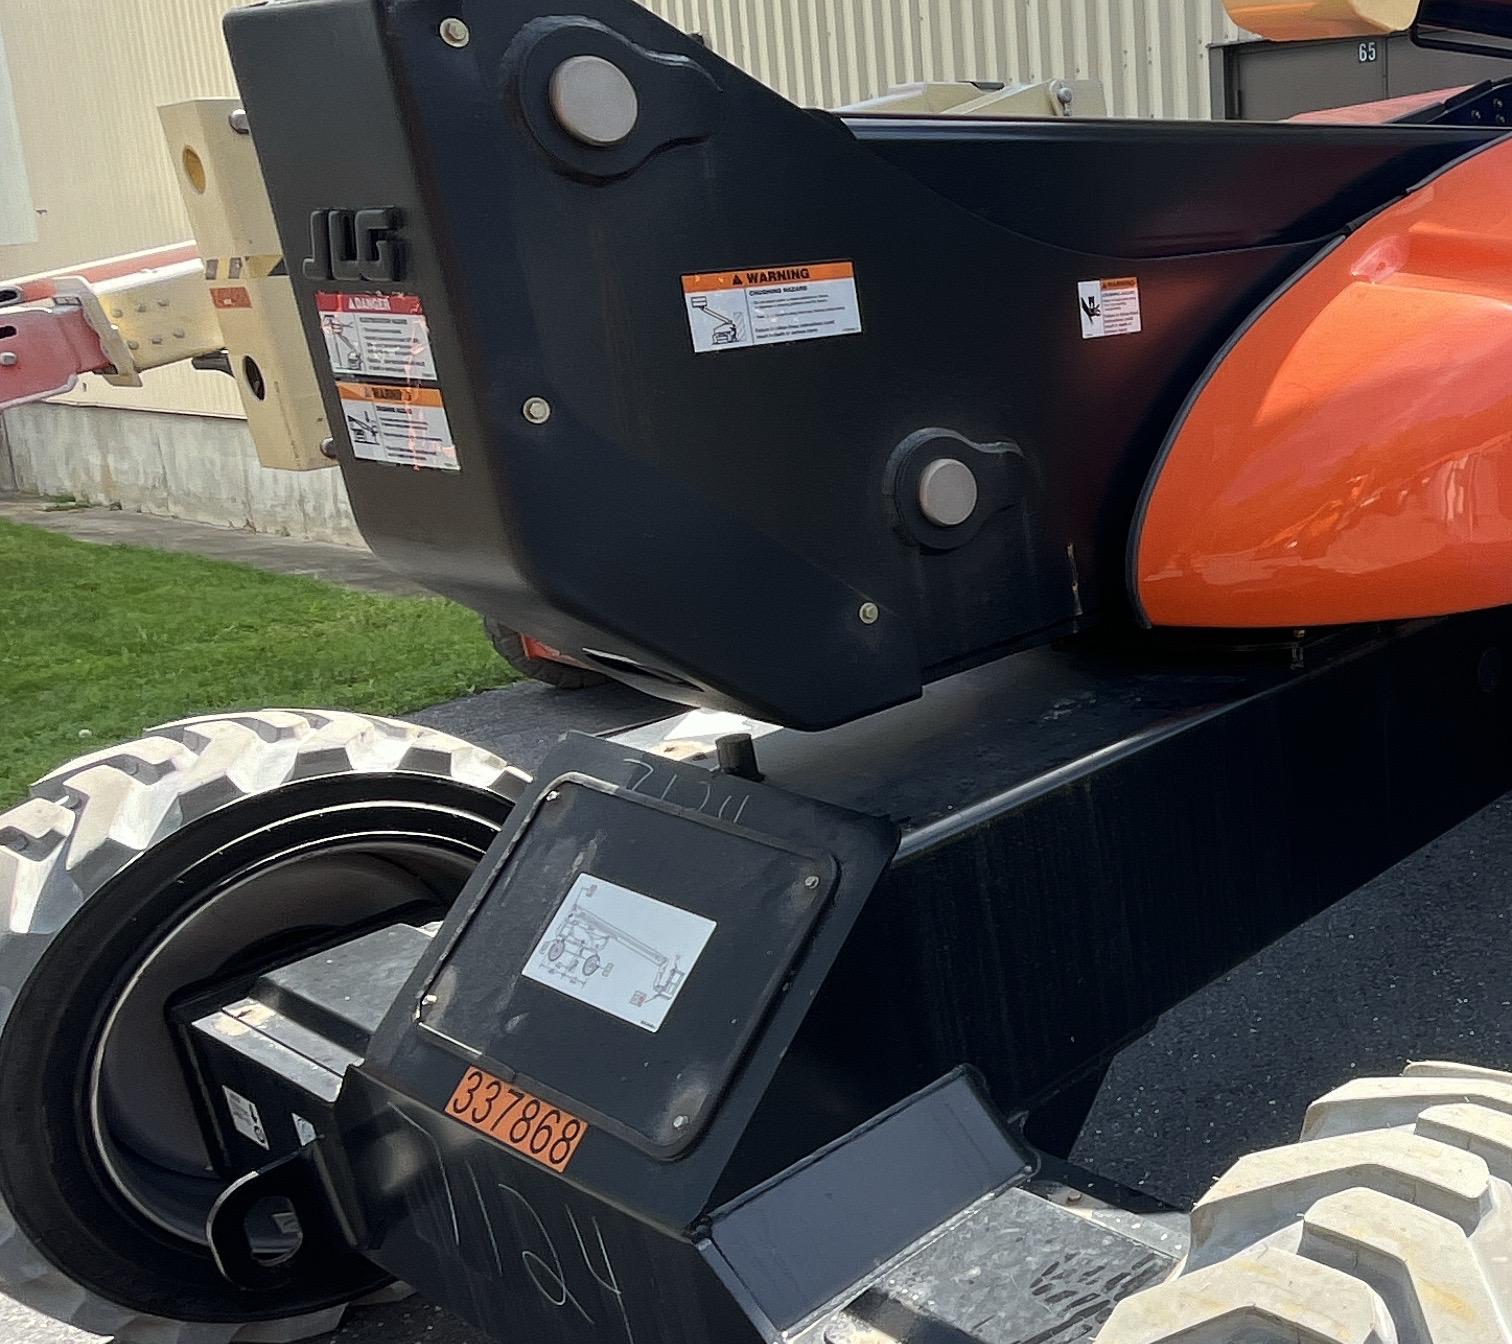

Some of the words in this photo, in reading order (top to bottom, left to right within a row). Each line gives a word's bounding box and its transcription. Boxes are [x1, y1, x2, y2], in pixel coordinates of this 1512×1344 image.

[1359, 42, 1376, 62] 65
[302, 206, 405, 282] JLG
[747, 268, 810, 284] WARNING
[452, 1070, 581, 1165] 337868
